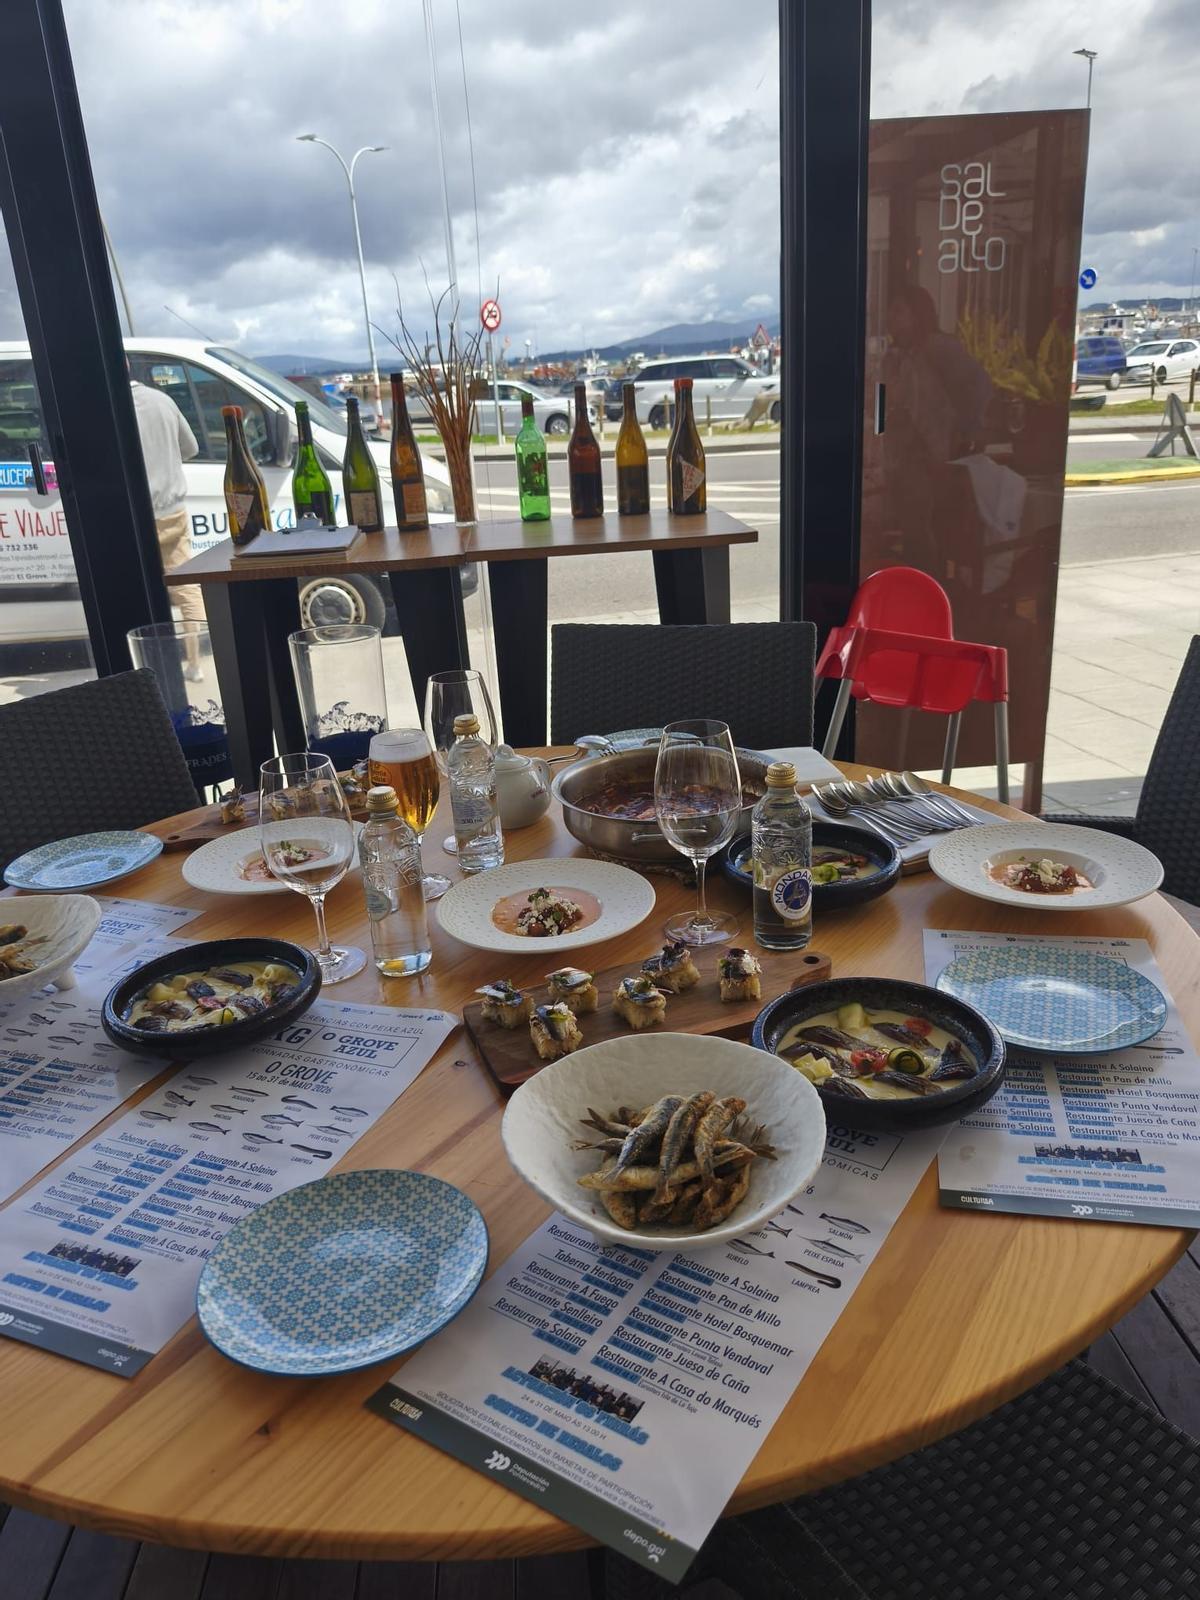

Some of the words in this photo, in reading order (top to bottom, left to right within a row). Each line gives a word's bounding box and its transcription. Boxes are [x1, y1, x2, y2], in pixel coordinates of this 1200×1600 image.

[333, 1044, 378, 1060] AZUL
[338, 1034, 400, 1051] GROVE
[280, 1063, 338, 1085] GROVE
[289, 1080, 312, 1091] MAIO
[1056, 1072, 1112, 1083] Restaurante
[1113, 1075, 1130, 1083] Pan
[1134, 1076, 1146, 1085] de
[1059, 1085, 1116, 1096] Restaurante
[1117, 1088, 1143, 1097] Hotel
[1145, 1089, 1200, 1100] Bosquemar
[1062, 1098, 1119, 1109] Restaurante
[1121, 1101, 1151, 1111] Punta
[1152, 1103, 1199, 1113] Vendaval
[959, 1118, 1016, 1130] Restaurante
[1066, 1112, 1123, 1123] Restaurante
[1125, 1114, 1153, 1124] Jueso
[1155, 1116, 1168, 1125] de
[1069, 1126, 1128, 1137] Restaurante
[1130, 1129, 1139, 1137] A
[1141, 1129, 1164, 1139] Casa
[1166, 1130, 1180, 1140] do
[195, 1150, 240, 1168] Restaurante
[239, 1161, 249, 1169] A
[248, 1162, 278, 1177] Solaina
[65, 1171, 109, 1189] Restaurante
[108, 1183, 117, 1191] A
[164, 1179, 209, 1197] Restaurante
[208, 1189, 232, 1203] Hotel
[180, 1165, 226, 1183] Restaurante
[224, 1175, 240, 1186] Pan
[240, 1178, 252, 1188] de
[251, 1181, 273, 1193] Millo
[45, 1186, 89, 1205] Restaurante
[147, 1194, 193, 1212] Restaurante
[192, 1206, 217, 1219] Punta
[30, 1202, 75, 1221] Restaurante
[130, 1209, 177, 1229] Restaurante
[175, 1221, 199, 1235] Jueso
[199, 1227, 211, 1237] de
[112, 1225, 158, 1245] Restaurante
[157, 1237, 167, 1247] A
[166, 1240, 186, 1253] Casa
[187, 1245, 199, 1256] do
[548, 1224, 600, 1252] Restaurante
[616, 1251, 628, 1263] de
[628, 1257, 649, 1273] Allo
[554, 1249, 591, 1271] Taberna
[590, 1265, 634, 1290] Herlogón
[673, 1253, 729, 1283] Restaurante
[730, 1277, 740, 1288] A
[740, 1280, 780, 1303] Solaina
[526, 1261, 580, 1290] Restaurante
[579, 1285, 590, 1296] A
[589, 1288, 619, 1312] Fuego
[658, 1270, 717, 1302] Restaurante
[717, 1294, 737, 1310] Pan
[739, 1302, 753, 1316] de
[753, 1309, 781, 1328] Millo
[506, 1277, 559, 1309] Restaurante
[560, 1301, 603, 1328] Senlleiro
[495, 1297, 550, 1330] Restaurante
[550, 1322, 587, 1347] Solaina
[644, 1288, 703, 1320] Restaurante
[704, 1311, 734, 1332] Hotel
[733, 1324, 794, 1357] Bosquemar
[629, 1306, 689, 1339] Restaurante
[689, 1331, 721, 1353] Punta
[723, 1345, 774, 1376] Vendaval
[614, 1325, 674, 1360] Restaurante
[673, 1353, 704, 1374] Jueso
[706, 1366, 720, 1381] de
[722, 1374, 750, 1394] Caña
[597, 1344, 658, 1380] Restaurante
[657, 1373, 669, 1386] A
[669, 1378, 695, 1398] Casa
[696, 1391, 711, 1405] do
[711, 1397, 762, 1428] Marqués
